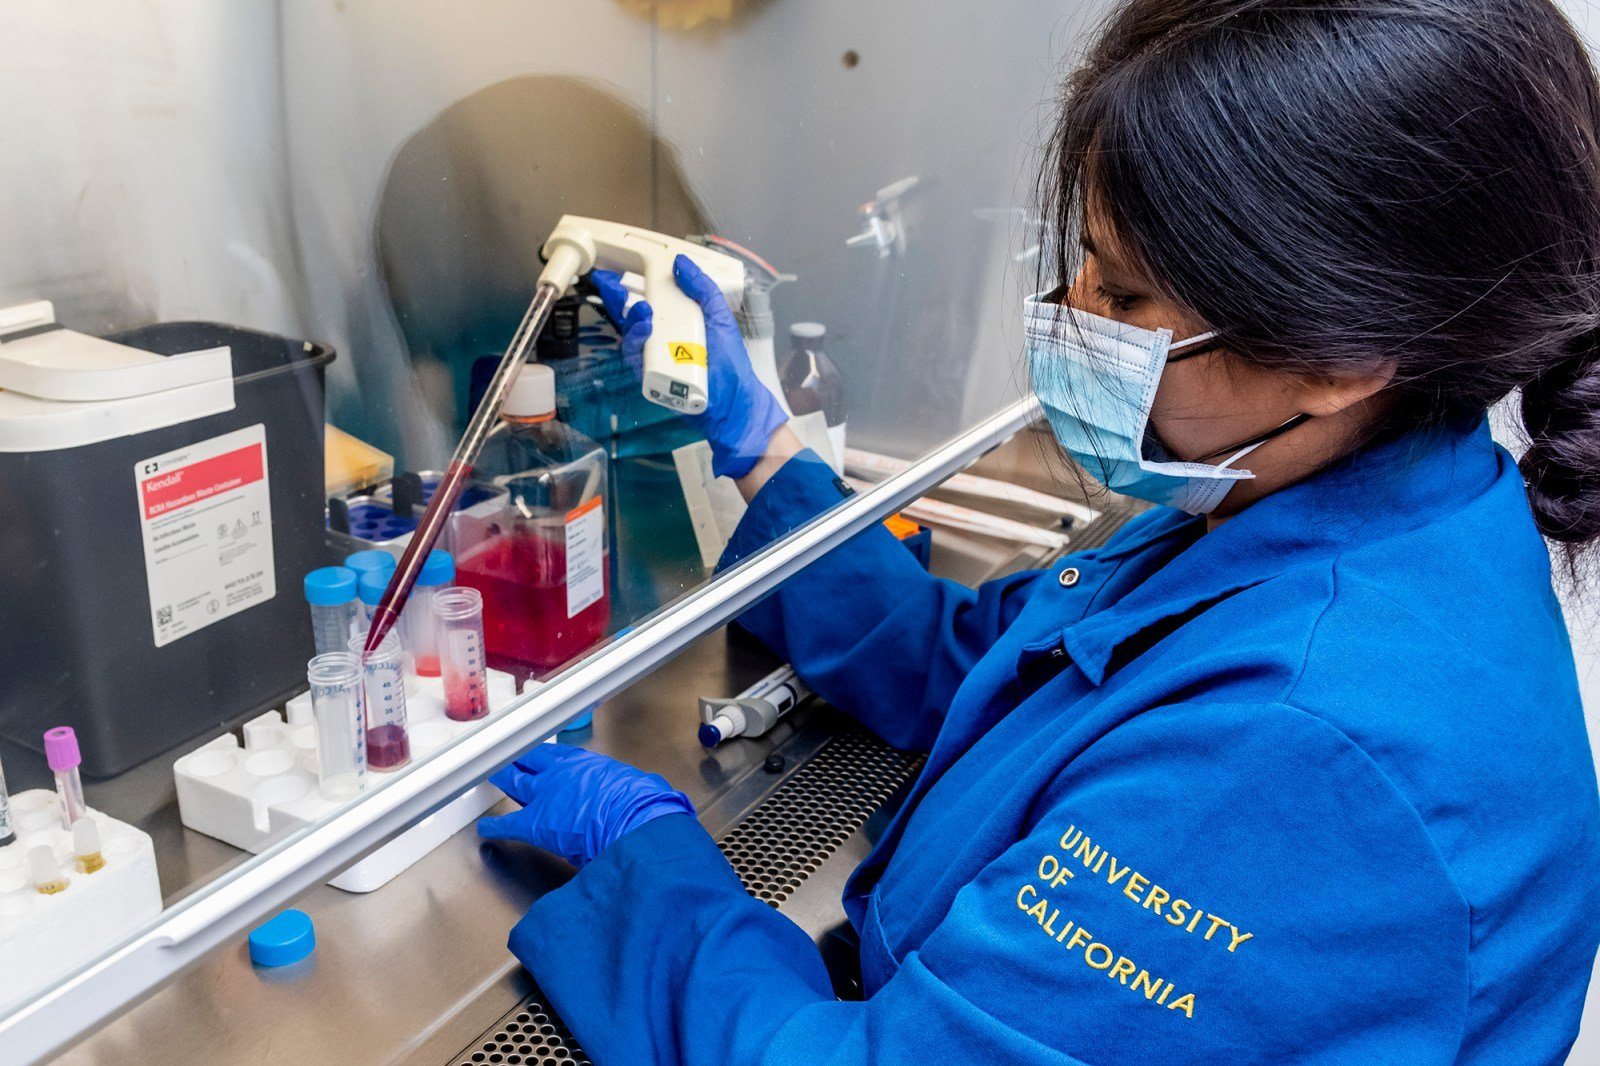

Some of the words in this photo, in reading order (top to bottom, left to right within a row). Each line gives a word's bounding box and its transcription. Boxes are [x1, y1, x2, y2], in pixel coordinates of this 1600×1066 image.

[1037, 855, 1075, 889] OF
[1060, 824, 1253, 952] UNIVERSITY
[1016, 884, 1197, 1018] CALIFORNIA
